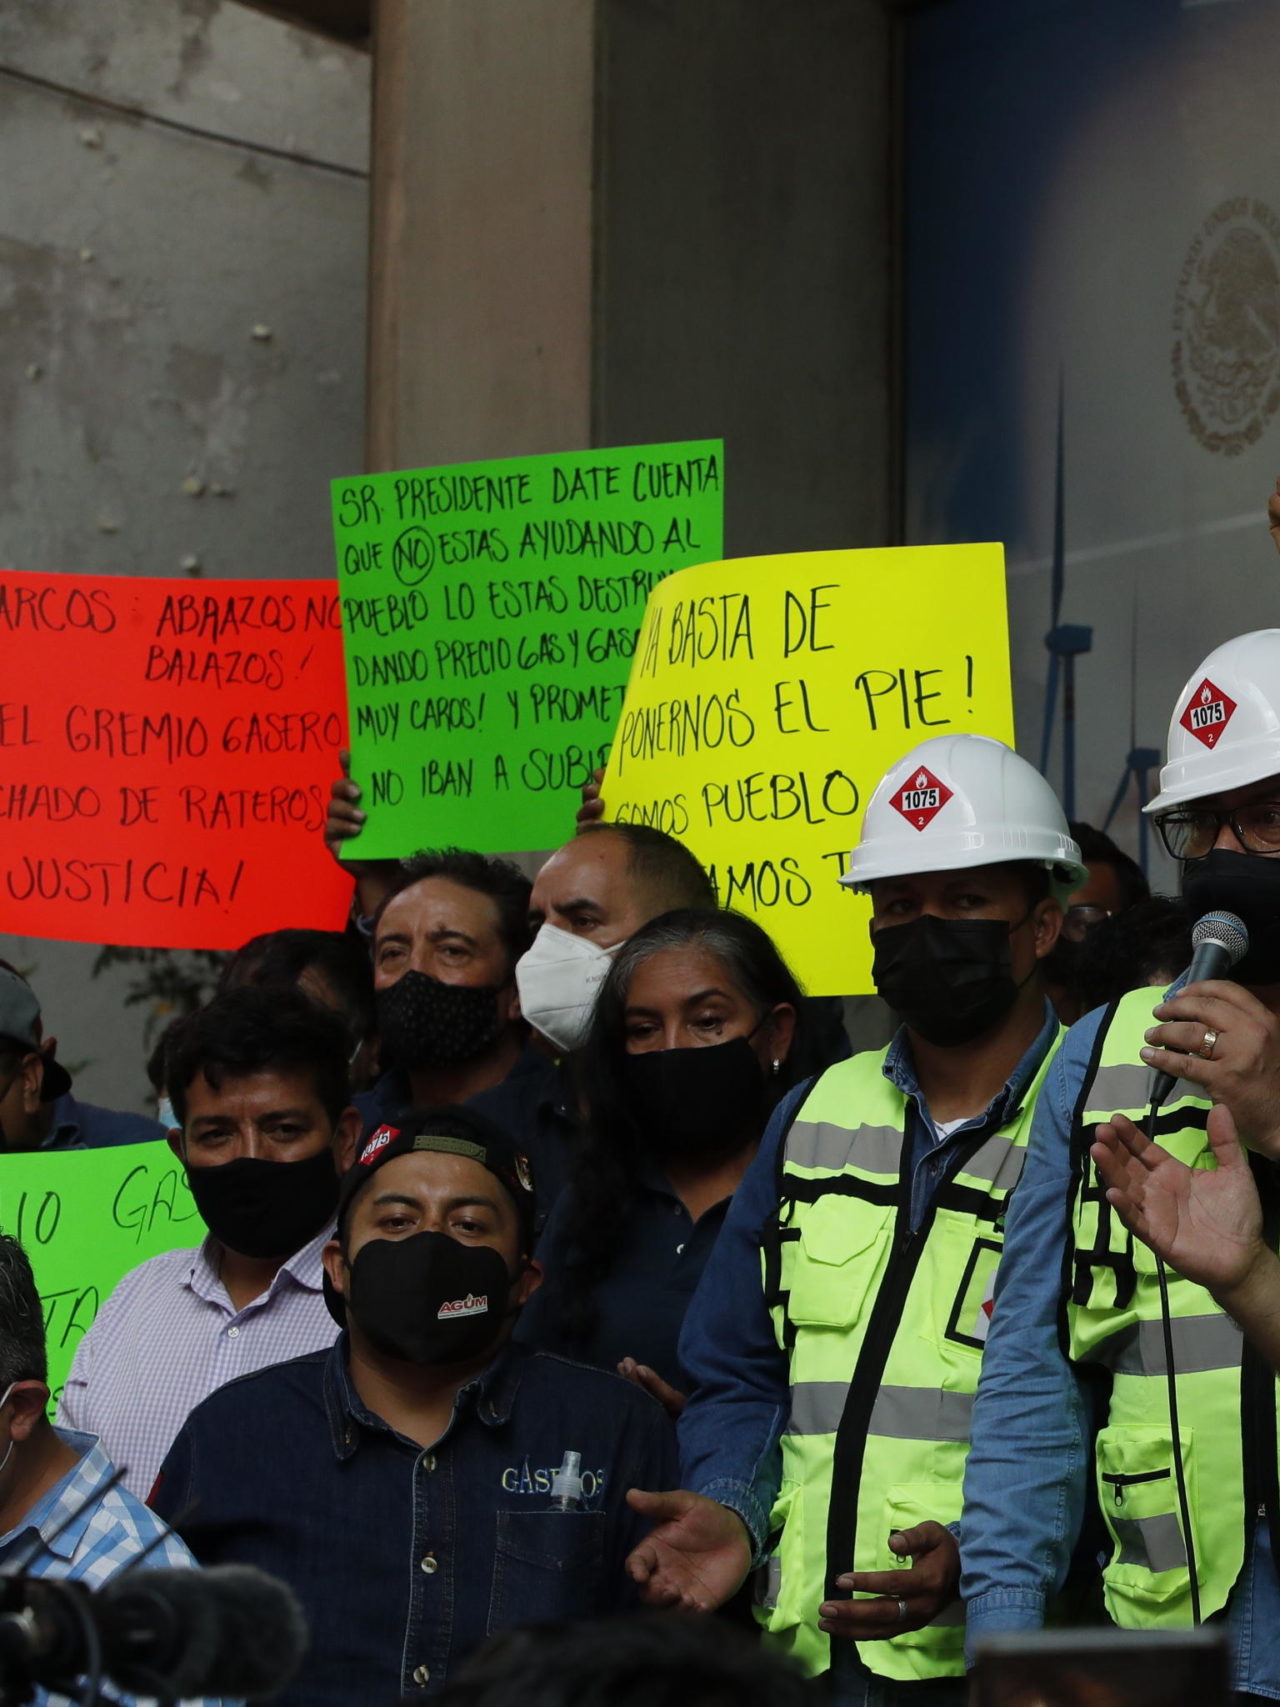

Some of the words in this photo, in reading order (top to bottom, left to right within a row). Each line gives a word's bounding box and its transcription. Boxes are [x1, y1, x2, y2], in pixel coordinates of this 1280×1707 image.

[394, 473, 532, 521] PRESIDENTE
[553, 465, 620, 504] DATE
[633, 455, 720, 502] CUENTA
[344, 541, 385, 575] QUE
[395, 531, 432, 577] NO
[439, 528, 510, 566] ESTAS
[519, 520, 655, 560] AYUDANDO
[662, 517, 701, 553] AL
[345, 590, 428, 637] PUEBLO
[444, 582, 475, 622] LO
[489, 575, 569, 619] ESTAS
[668, 593, 754, 669] BASTA
[784, 584, 841, 659] DE
[353, 649, 429, 688] DANDO
[434, 639, 511, 681] PRECIO
[516, 633, 566, 671] GAS
[567, 628, 580, 669] Y
[66, 704, 209, 765] GREMIO
[222, 711, 342, 754] GASERO
[356, 698, 400, 745] MUY
[506, 689, 520, 730] Y
[618, 688, 755, 778] PONERNOS
[774, 679, 831, 734] EL
[1192, 701, 1223, 727] 1075
[119, 786, 161, 827] DE
[179, 784, 327, 832] RATEROS
[371, 772, 404, 808] NO
[421, 757, 473, 799] IBAN
[493, 754, 510, 792] A
[702, 770, 859, 827] PUEBLO
[904, 788, 937, 809] 1075
